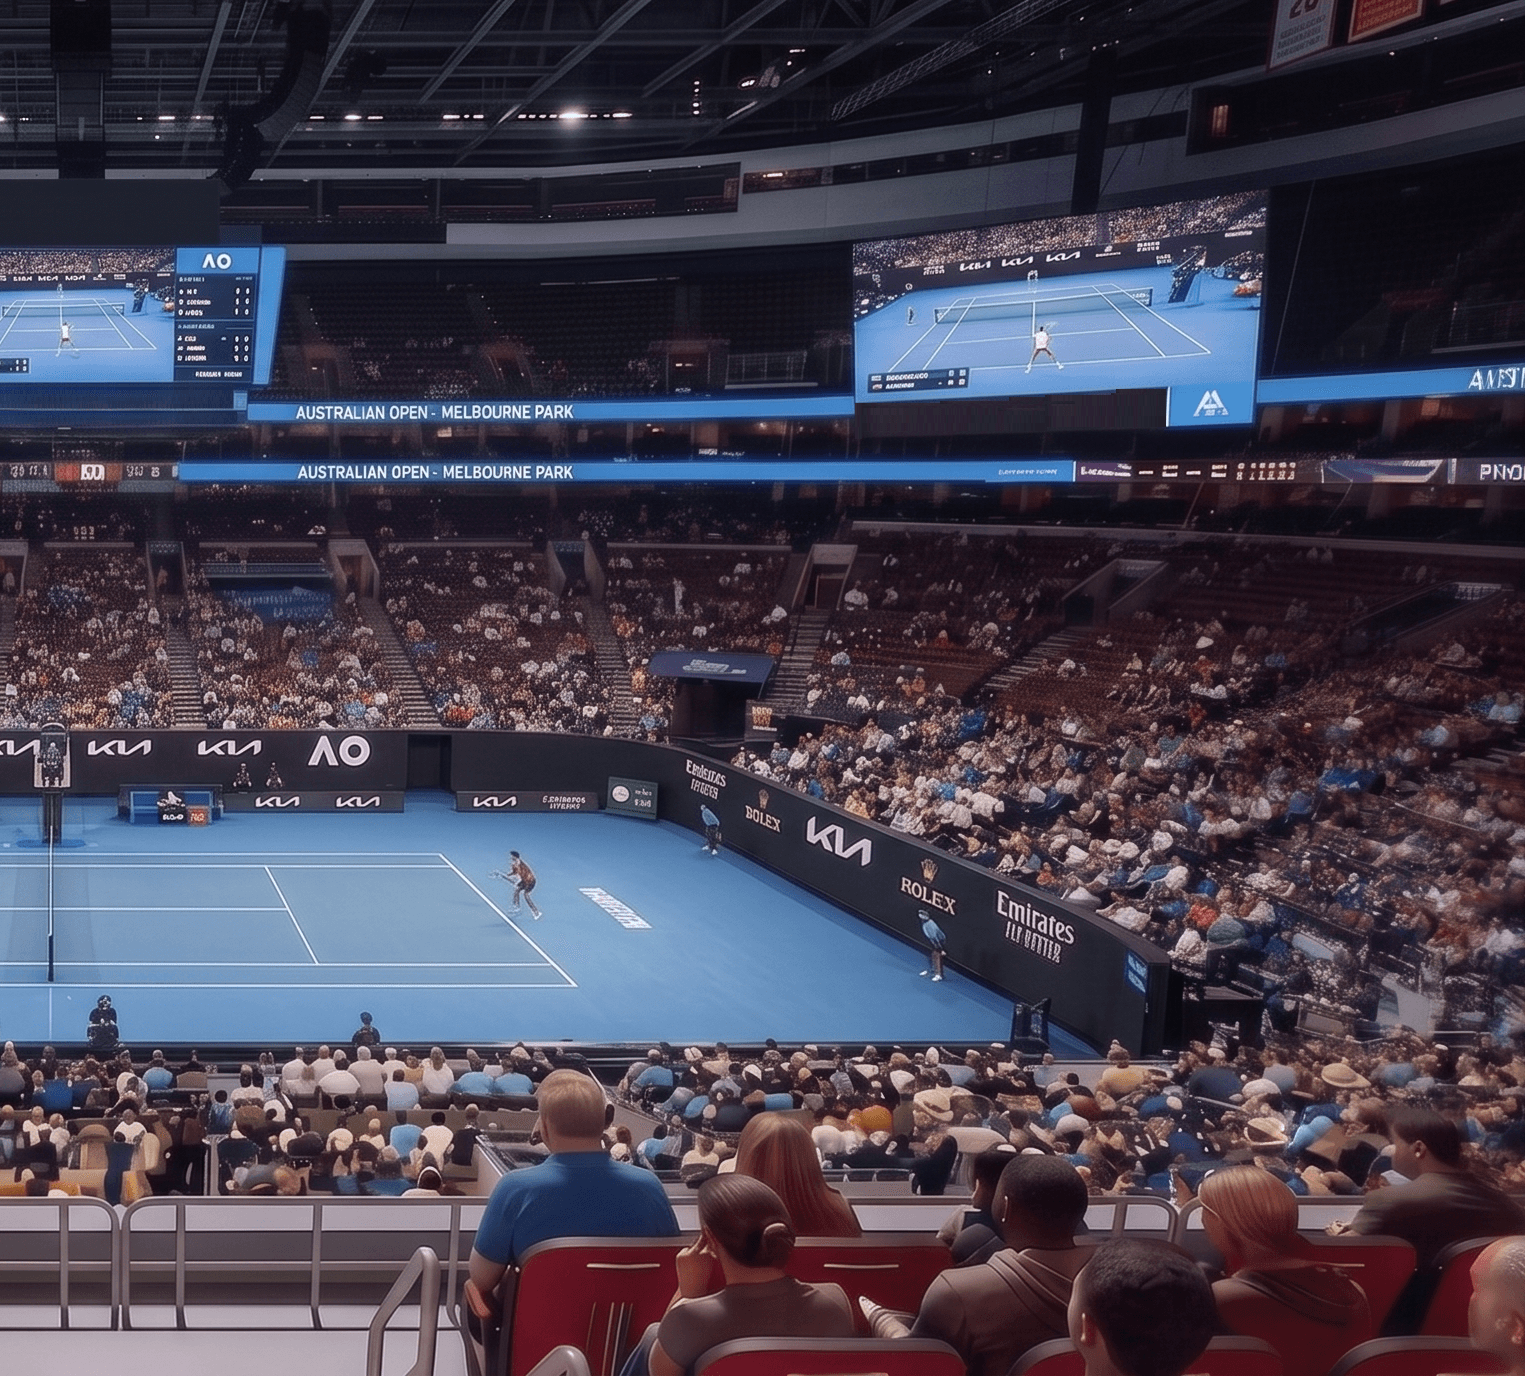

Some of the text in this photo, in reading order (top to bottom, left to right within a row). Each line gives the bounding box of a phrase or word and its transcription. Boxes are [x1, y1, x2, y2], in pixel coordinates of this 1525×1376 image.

[295, 405, 385, 420] AUSTRALIAN
[389, 405, 428, 420] OPEN
[441, 404, 531, 420] MELBOURNE
[535, 404, 574, 419] PARK
[297, 465, 387, 480] AUSTRALIAN
[391, 465, 430, 479] OPEN
[443, 465, 532, 480] MELBOURNE
[535, 465, 574, 479] PARK
[87, 739, 152, 756] KIA
[197, 739, 262, 756] KIA
[307, 735, 371, 767] AO
[255, 796, 380, 807] KIA KIA
[473, 796, 517, 808] KIA
[806, 815, 872, 867] KIA
[900, 876, 956, 916] ROLEX
[997, 889, 1075, 945] Emirates
